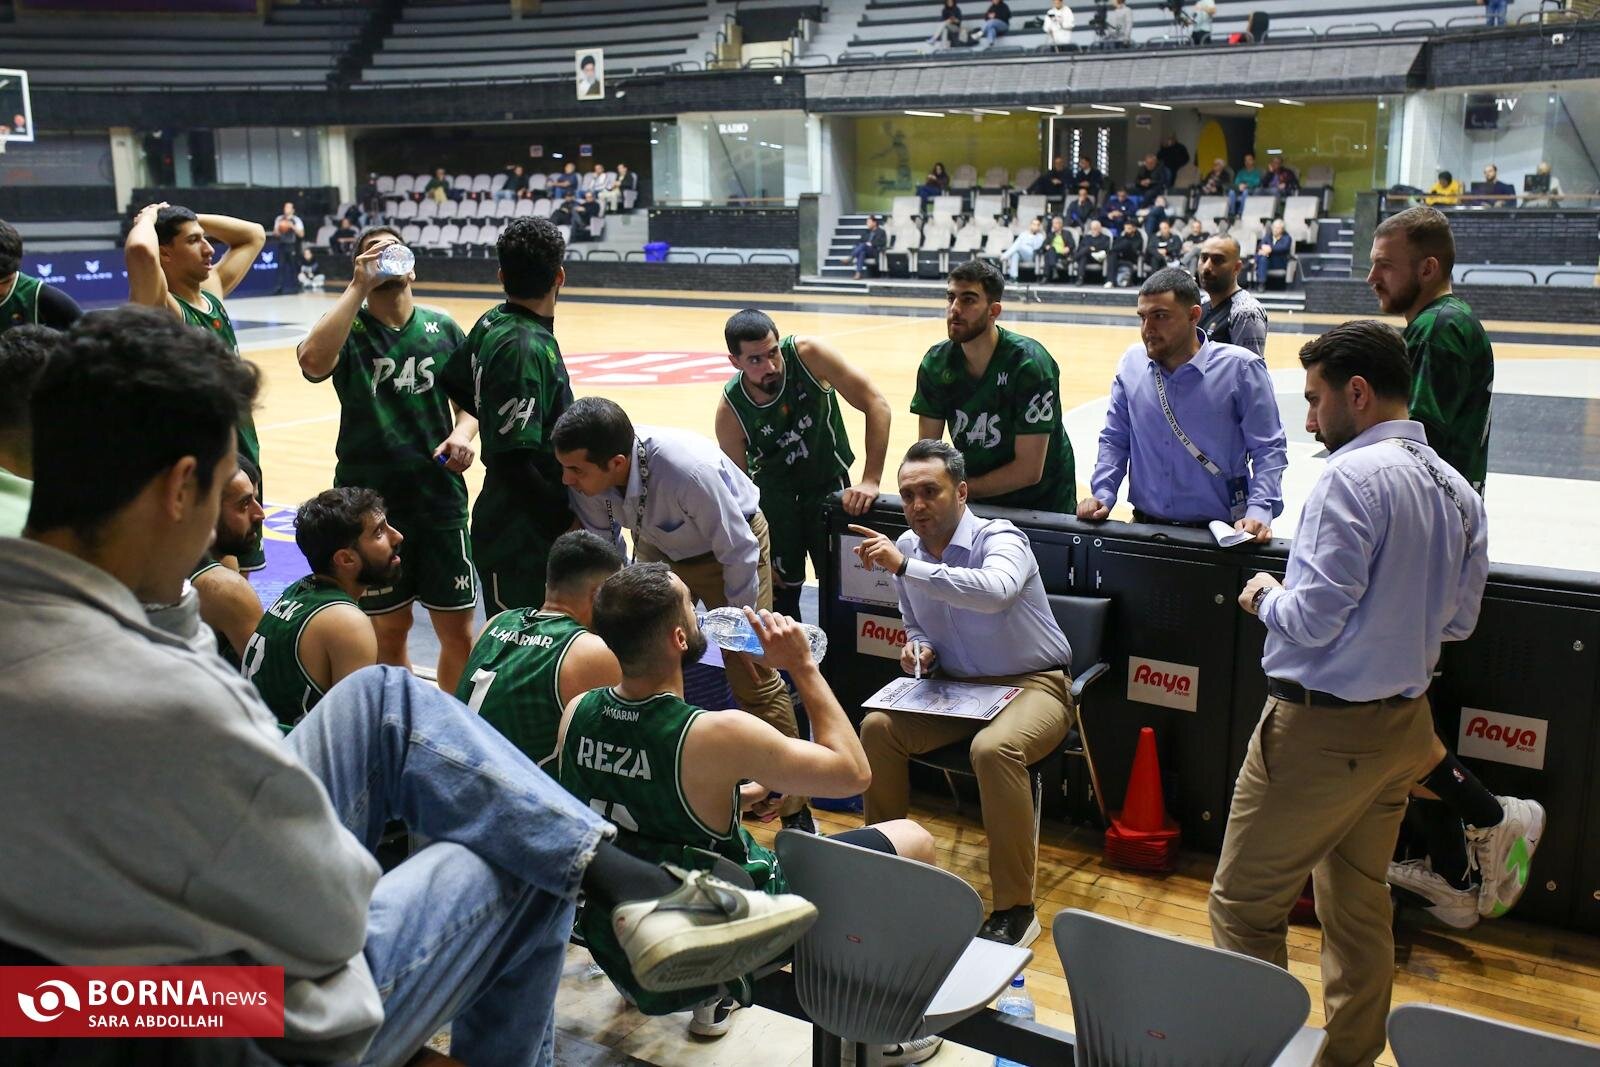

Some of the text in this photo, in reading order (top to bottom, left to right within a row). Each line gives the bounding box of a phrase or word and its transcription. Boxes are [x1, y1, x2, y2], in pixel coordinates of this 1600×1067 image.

[1495, 98, 1518, 111] TV
[719, 123, 748, 134] RADIO
[371, 356, 436, 397] PAS
[951, 409, 1002, 449] PAS
[861, 620, 908, 646] Raya
[468, 667, 498, 715] 1
[1133, 664, 1191, 693] Raya
[1466, 716, 1537, 748] Raya
[577, 735, 652, 780] REZA
